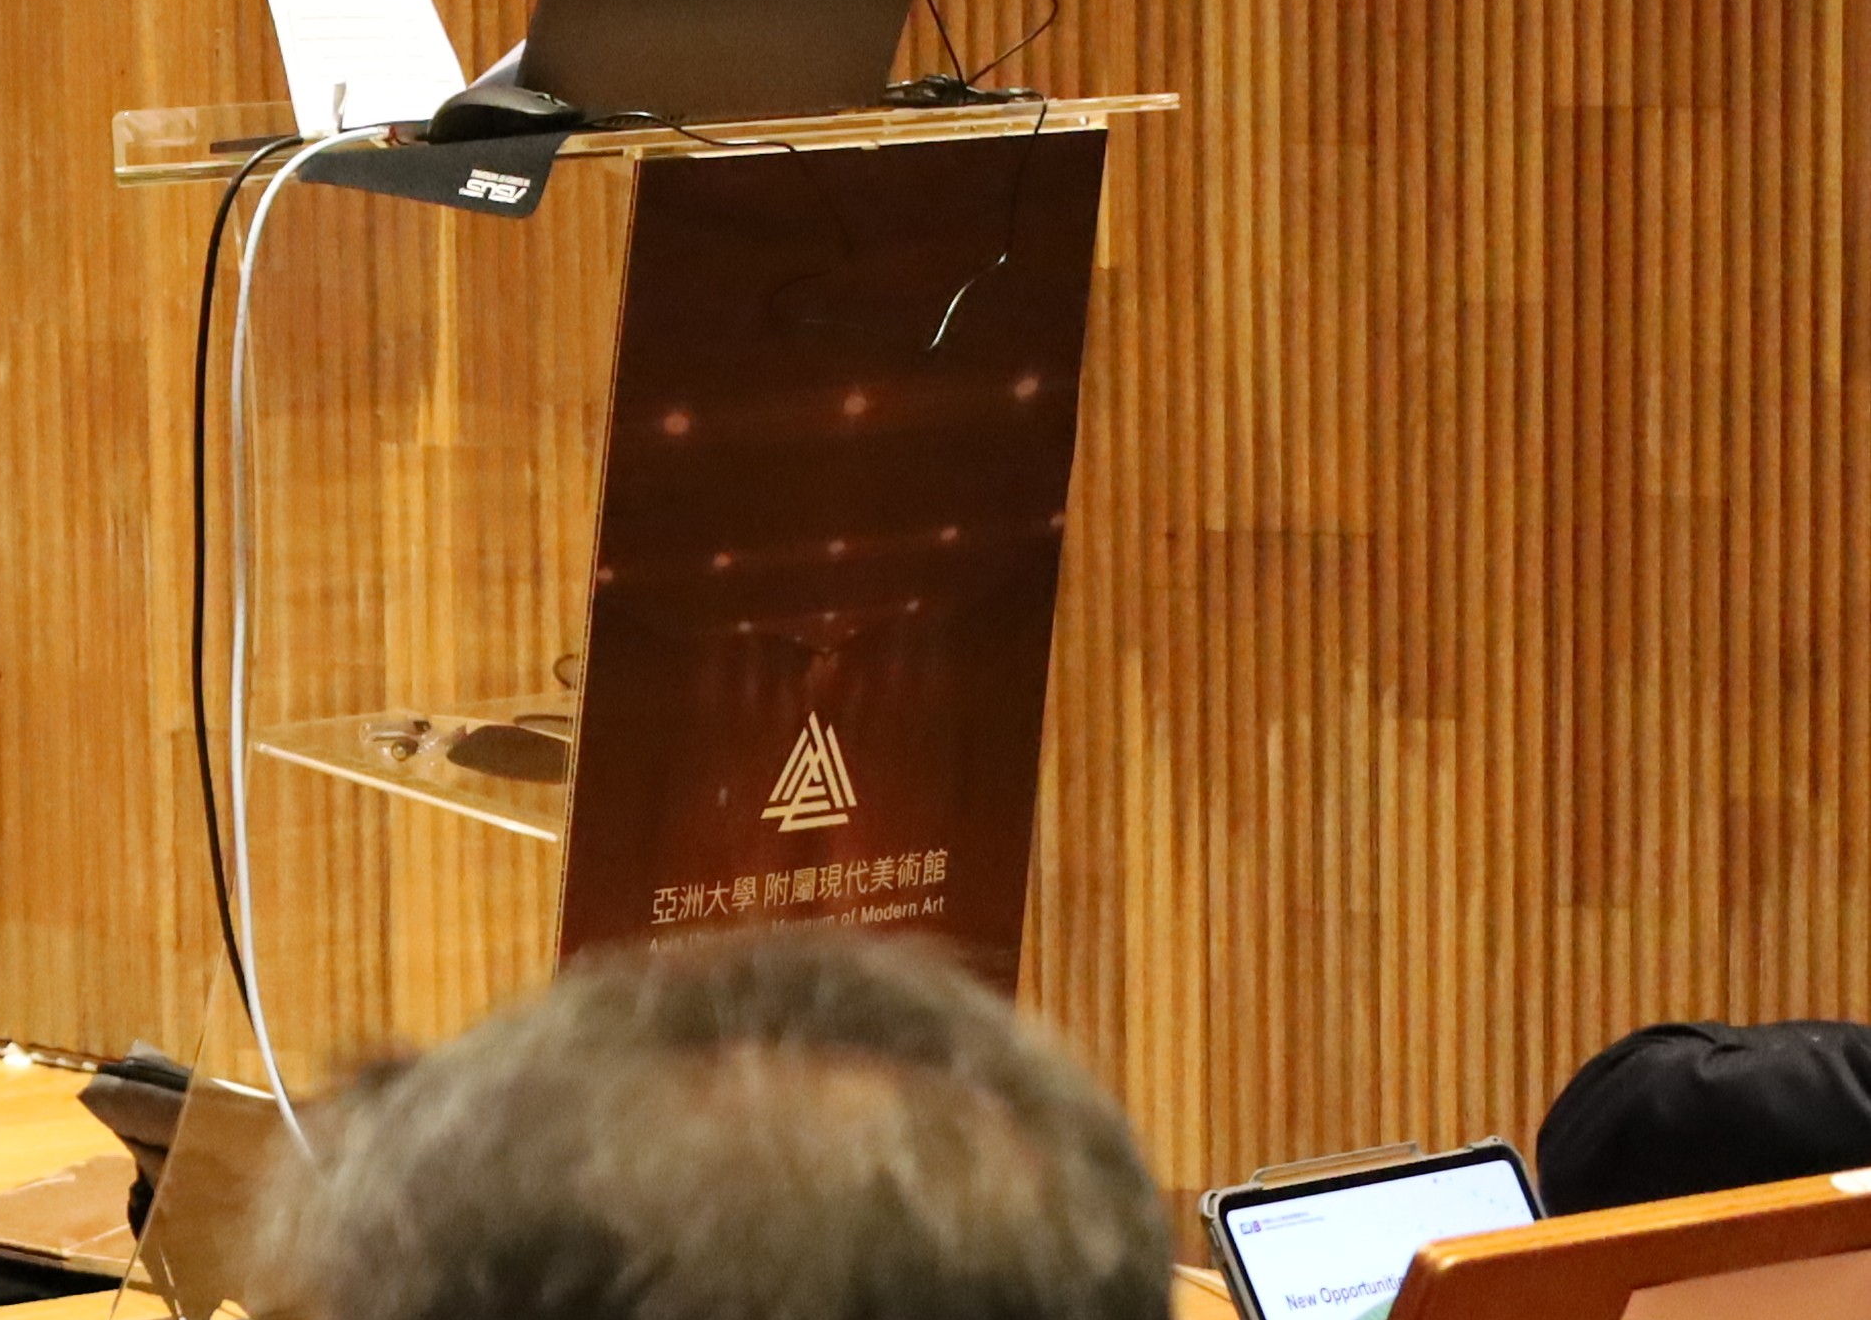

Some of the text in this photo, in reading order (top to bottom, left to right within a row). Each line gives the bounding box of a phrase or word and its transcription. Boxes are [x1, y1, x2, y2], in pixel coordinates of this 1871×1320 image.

[458, 178, 528, 204] ASUS
[650, 847, 949, 925] 亞洲大學 附屬現代美術館
[860, 902, 918, 925] Modern
[921, 894, 945, 916] Art
[1285, 1293, 1318, 1312] New
